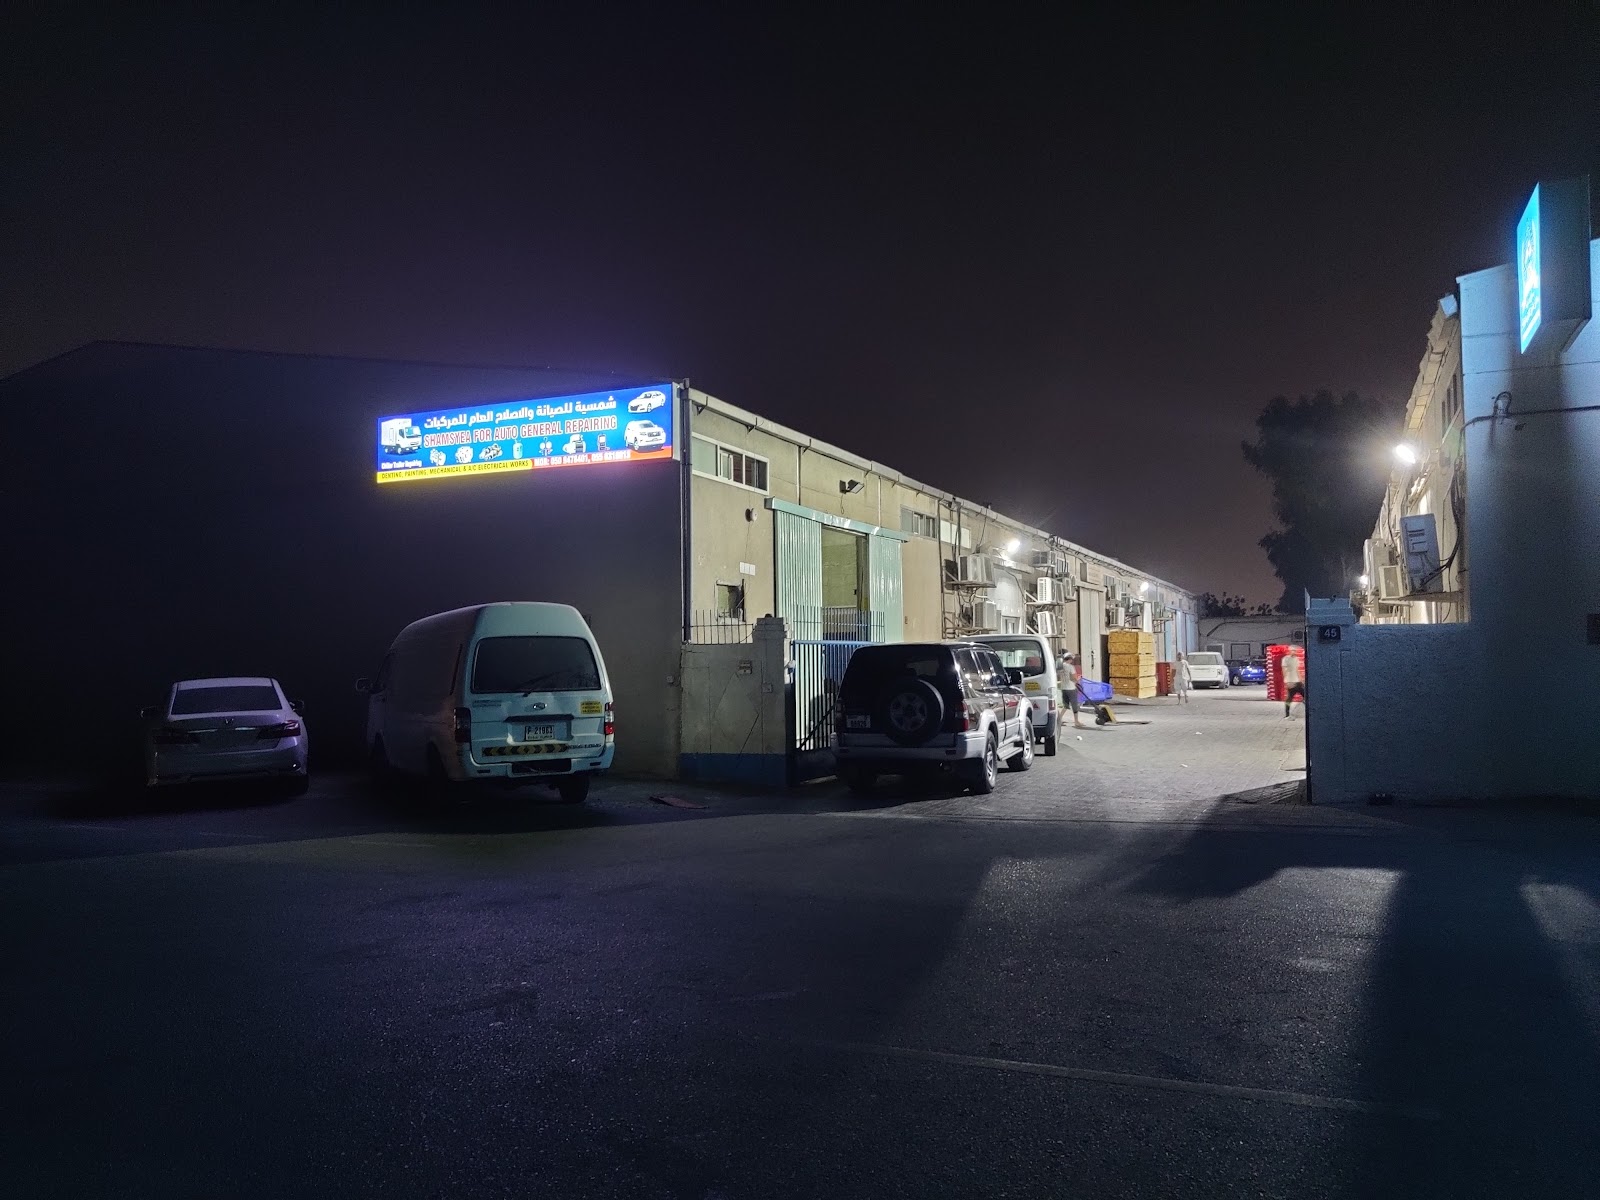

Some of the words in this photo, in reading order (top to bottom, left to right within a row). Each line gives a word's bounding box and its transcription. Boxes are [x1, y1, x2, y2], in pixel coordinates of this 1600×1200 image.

[536, 401, 573, 418] للصيانة
[575, 395, 617, 414] شمسية
[423, 413, 467, 430] للمركبات
[468, 410, 494, 427] العام
[424, 430, 472, 448] SHAMSYEA
[473, 427, 492, 443] FOR
[494, 424, 518, 441] AUTO
[520, 421, 563, 438] GENERAL
[565, 415, 617, 434] REPAIRING
[429, 465, 462, 474] MECHANICAL
[478, 461, 508, 470] ELECTRICAL
[510, 459, 529, 468] WORKS
[1324, 628, 1337, 638] 45
